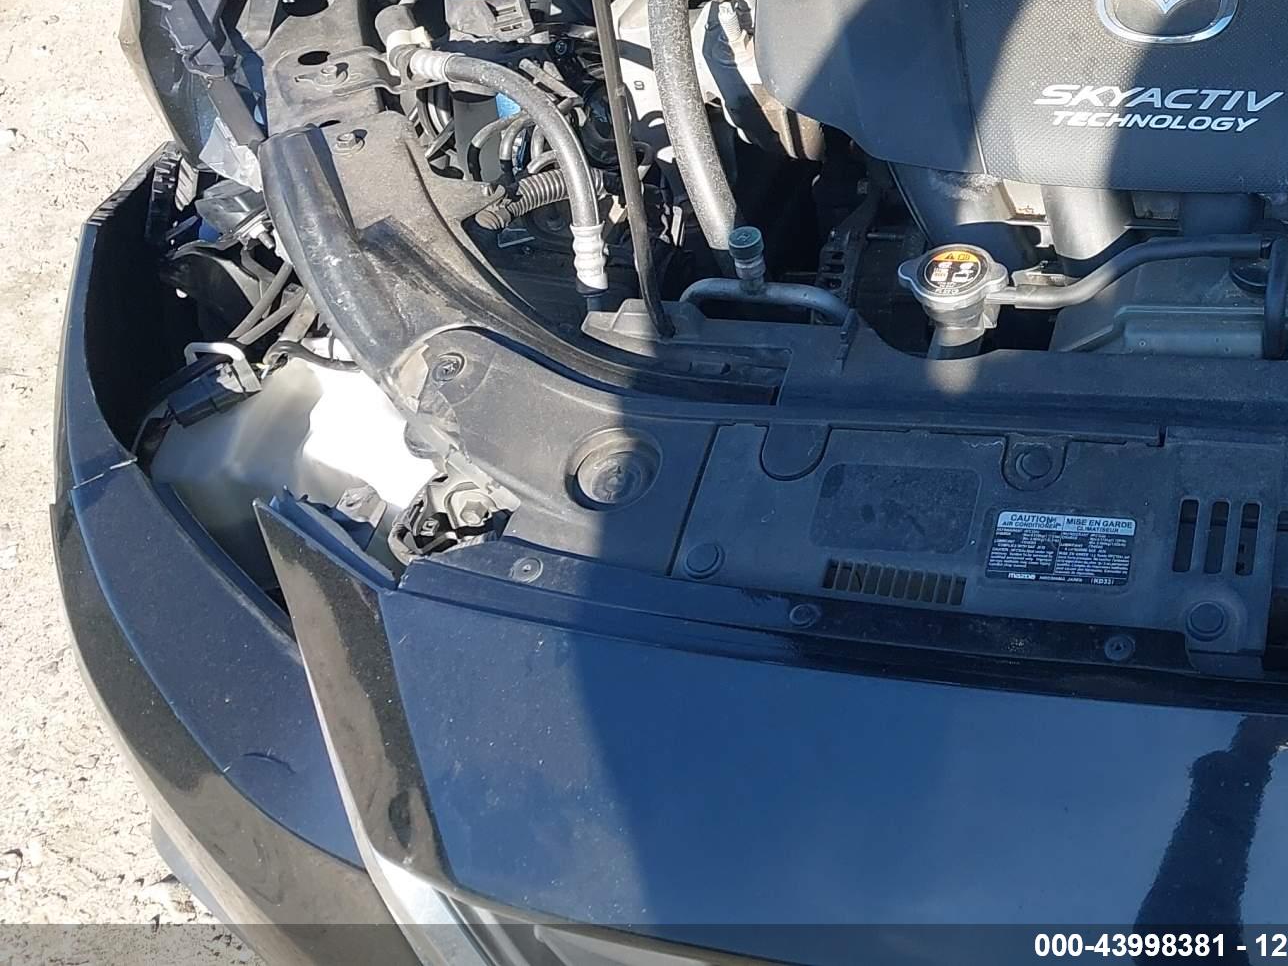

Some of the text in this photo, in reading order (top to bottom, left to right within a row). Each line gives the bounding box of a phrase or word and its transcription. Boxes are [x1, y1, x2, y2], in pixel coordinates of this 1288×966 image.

[1033, 84, 1285, 113] SKYACTIV
[1050, 110, 1259, 133] TECHNOLOGY
[1014, 521, 1057, 530] CONDITIONER
[1066, 518, 1133, 529] MISE EN GARDE
[1077, 525, 1119, 533] CLIMATISEUR
